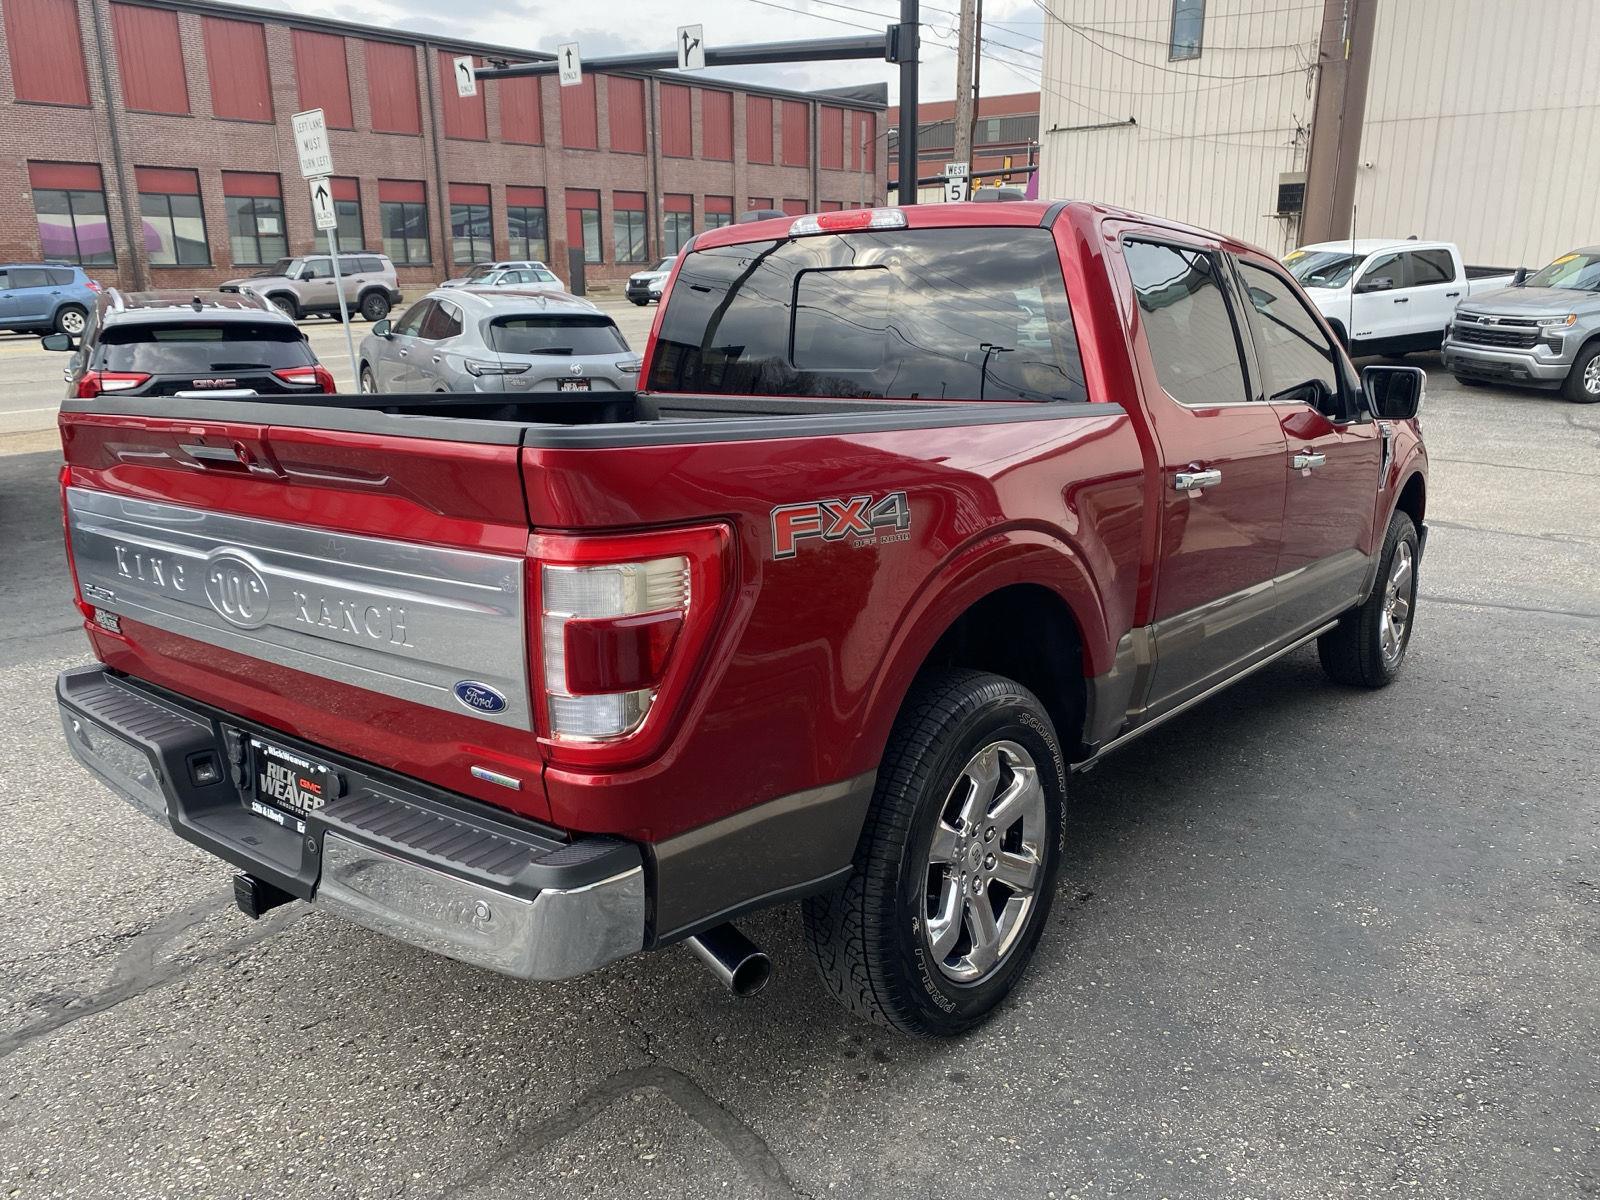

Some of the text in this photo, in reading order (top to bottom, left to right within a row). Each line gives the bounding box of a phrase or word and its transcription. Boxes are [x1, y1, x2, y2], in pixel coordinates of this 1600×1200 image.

[563, 71, 577, 80] ONLY
[460, 84, 473, 93] ONLY
[296, 117, 323, 134] LEFT LANE
[303, 136, 321, 152] MUST
[302, 155, 330, 170] TURN LEFT
[947, 165, 966, 175] WEST
[951, 184, 961, 201] 5
[192, 378, 236, 388] GMC
[770, 490, 912, 561] FX4
[853, 532, 911, 548] OFF ROAD
[114, 545, 189, 592] KING
[293, 591, 415, 648] RANCH
[464, 686, 494, 710] Ford
[267, 761, 296, 785] RICK
[260, 773, 325, 812] WEAVER
[300, 778, 321, 795] GMC
[914, 947, 957, 1014] PIRELLI
